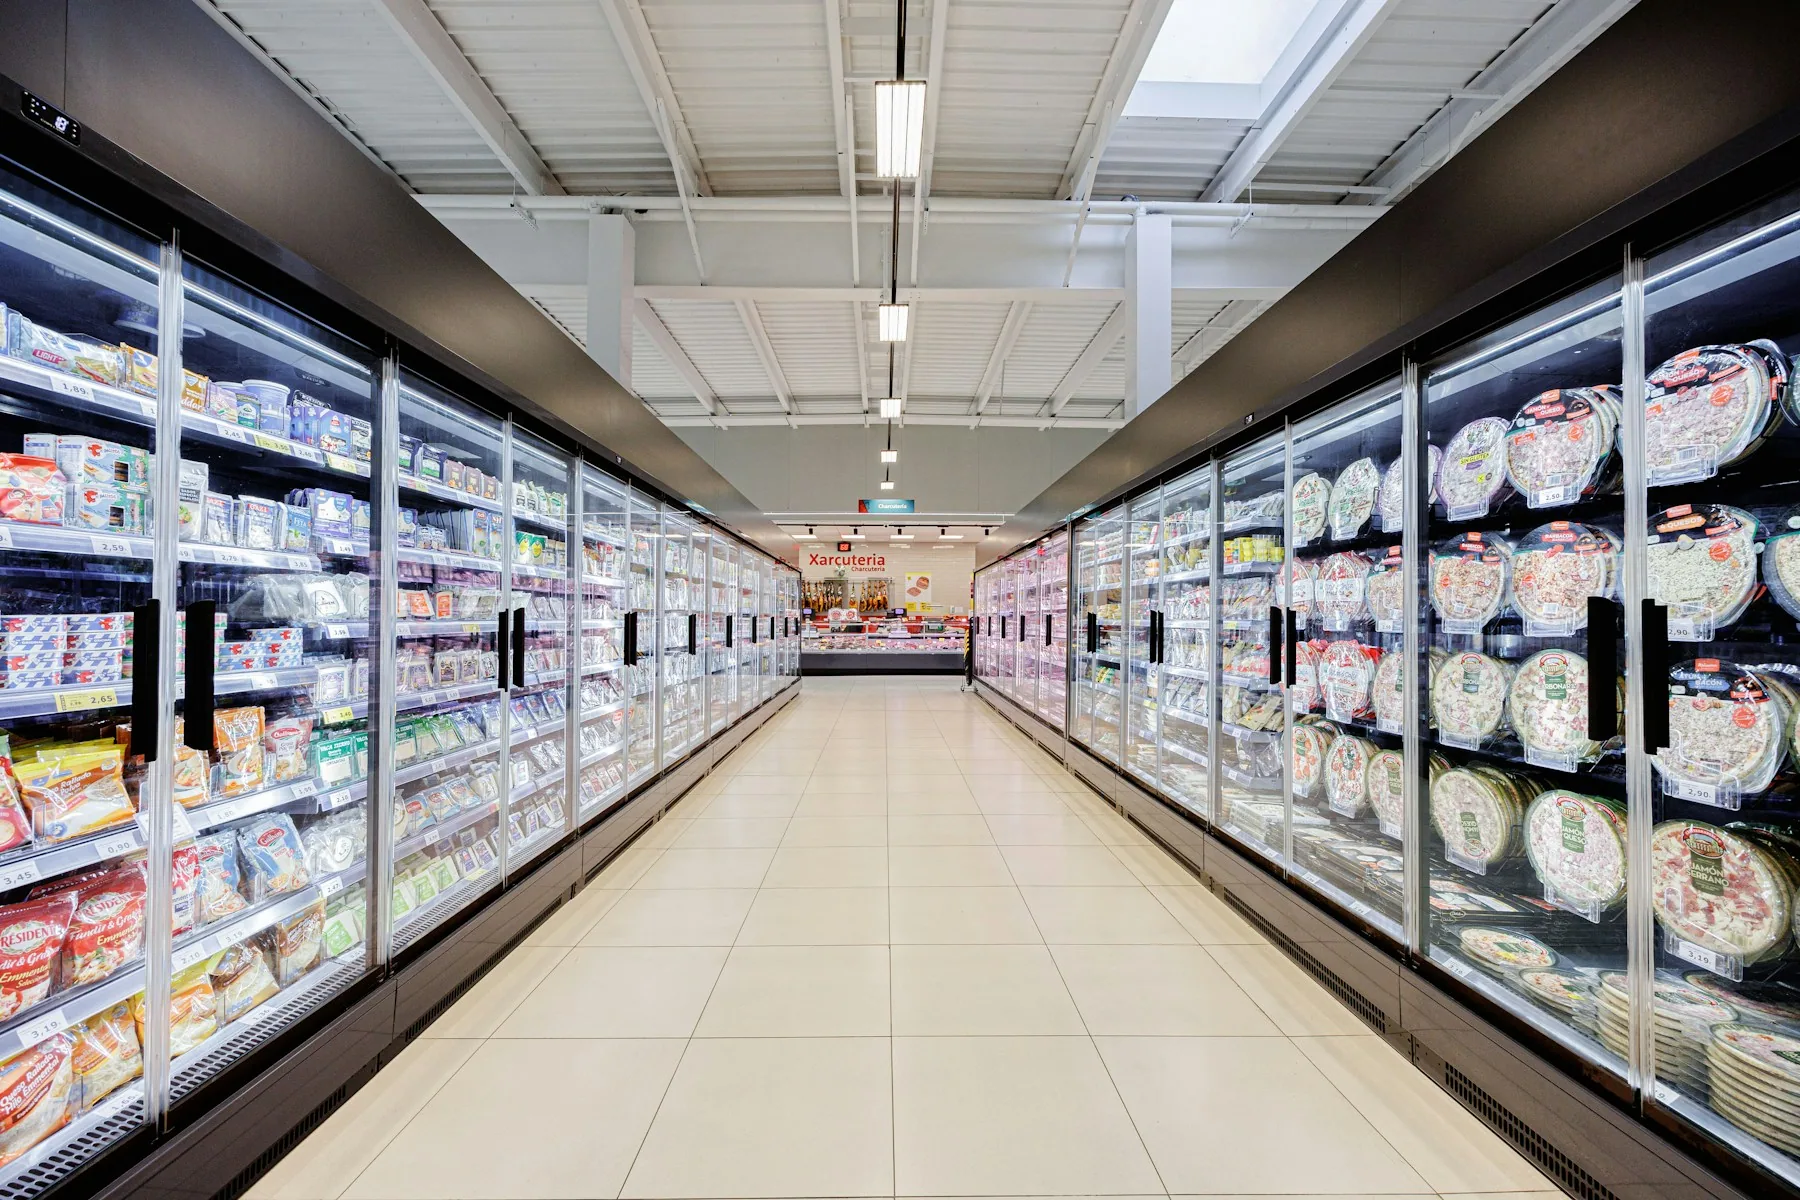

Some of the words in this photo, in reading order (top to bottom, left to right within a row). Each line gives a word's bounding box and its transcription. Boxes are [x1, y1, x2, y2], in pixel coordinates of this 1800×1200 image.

[36, 350, 59, 363] LIGHT
[62, 383, 86, 395] 1,89
[1667, 516, 1702, 530] QUESOS
[102, 543, 124, 551] 2,59
[809, 553, 885, 566] Xarcuteria
[1668, 628, 1688, 636] 2,90
[1694, 677, 1723, 686] BACÓN
[91, 695, 113, 704] 2,65
[61, 772, 92, 789] Rallado
[1688, 788, 1709, 798] 2,90
[1563, 832, 1588, 846] QUESO
[107, 842, 130, 854] 0,90
[1691, 862, 1724, 878] JAMÓN
[3, 872, 33, 885] 3,45
[1686, 869, 1730, 888] SERRANO
[69, 924, 106, 942] Fundir
[1688, 950, 1709, 964] 3,19
[31, 1021, 58, 1039] 3,19
[0, 1081, 26, 1106] Queso
[26, 1053, 54, 1081] Rallado
[22, 1056, 60, 1097] Emmental
